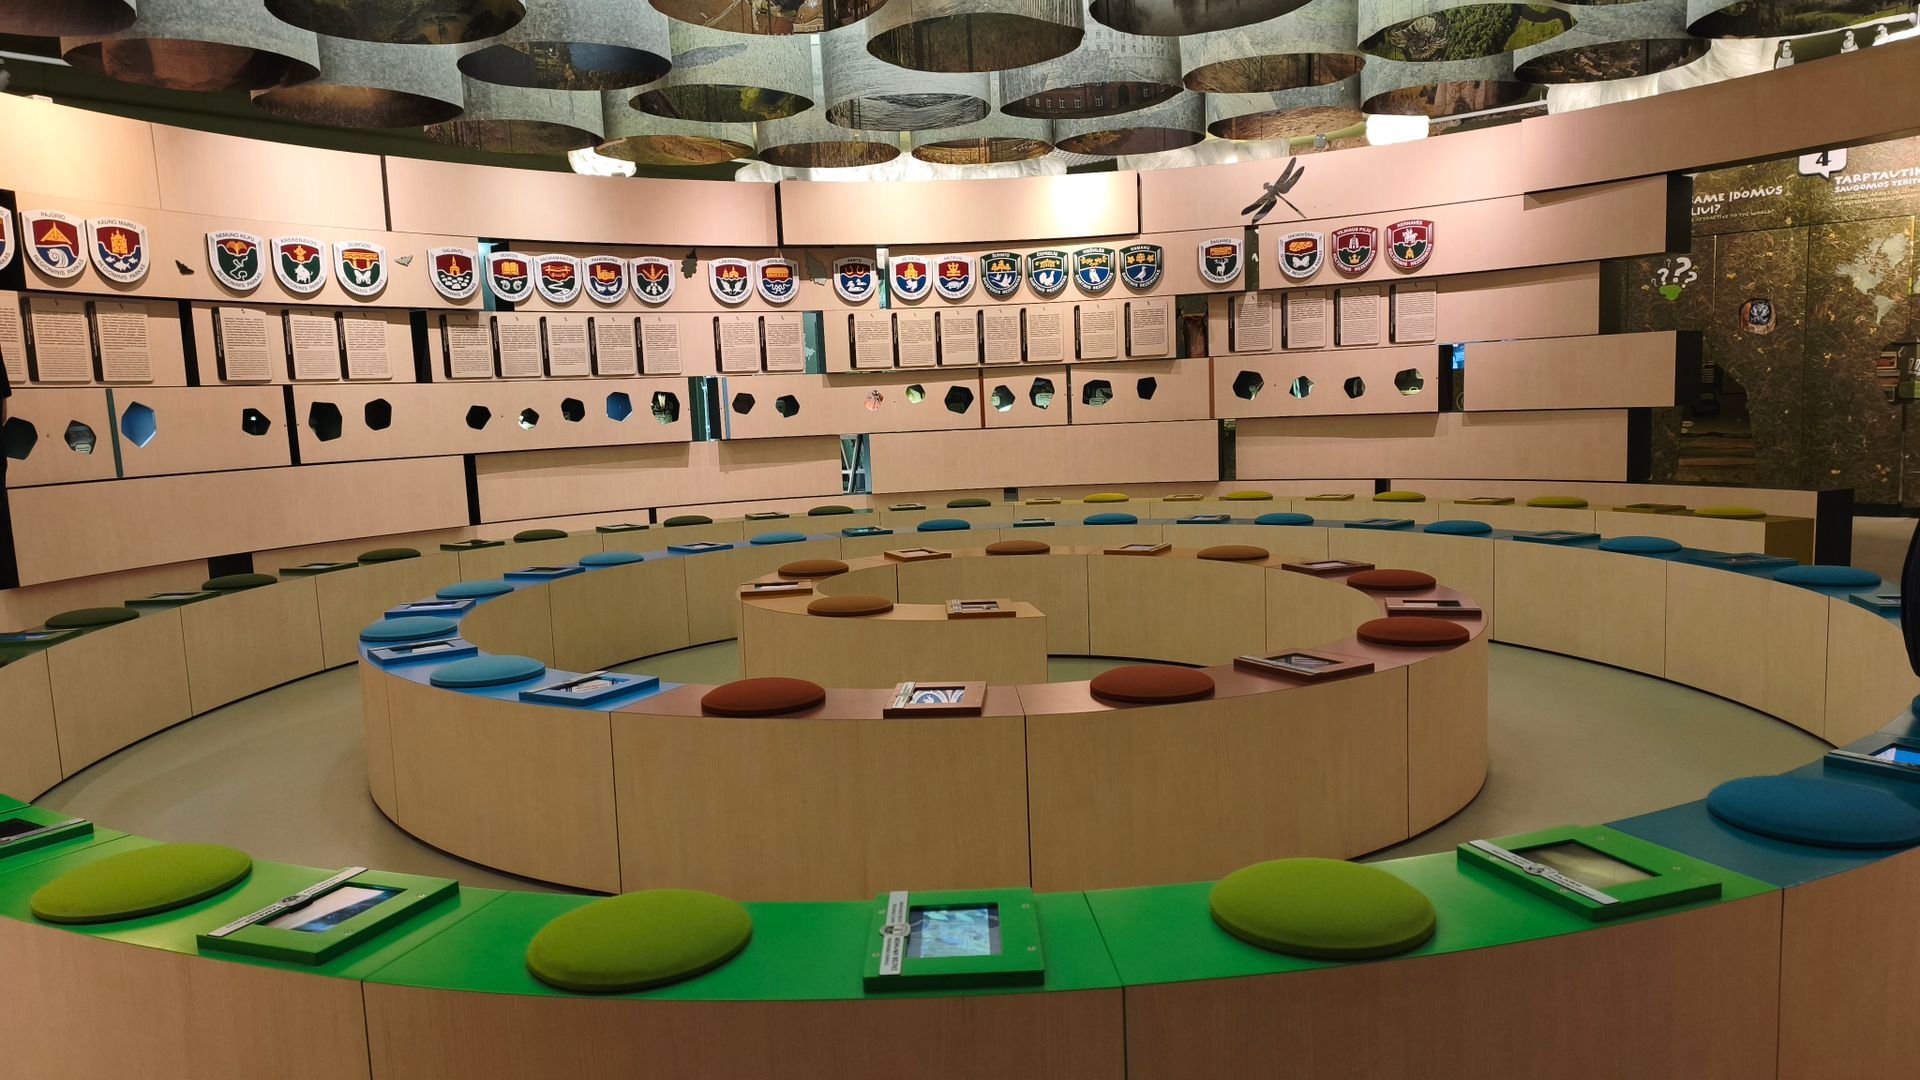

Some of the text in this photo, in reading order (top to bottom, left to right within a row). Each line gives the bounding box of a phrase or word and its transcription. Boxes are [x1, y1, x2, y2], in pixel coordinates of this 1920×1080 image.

[1815, 150, 1832, 166] 4
[1834, 181, 1889, 194] SAUGOMOS
[1692, 192, 1724, 204] AME
[34, 254, 83, 276] REGIONINIS PARKAS
[98, 260, 146, 280] REGIONINIS PARKAS
[217, 270, 262, 288] REGIONINIS PARKAS
[1226, 267, 1239, 280] PARKAS
[280, 274, 324, 291] REGIONINIS PARKAS
